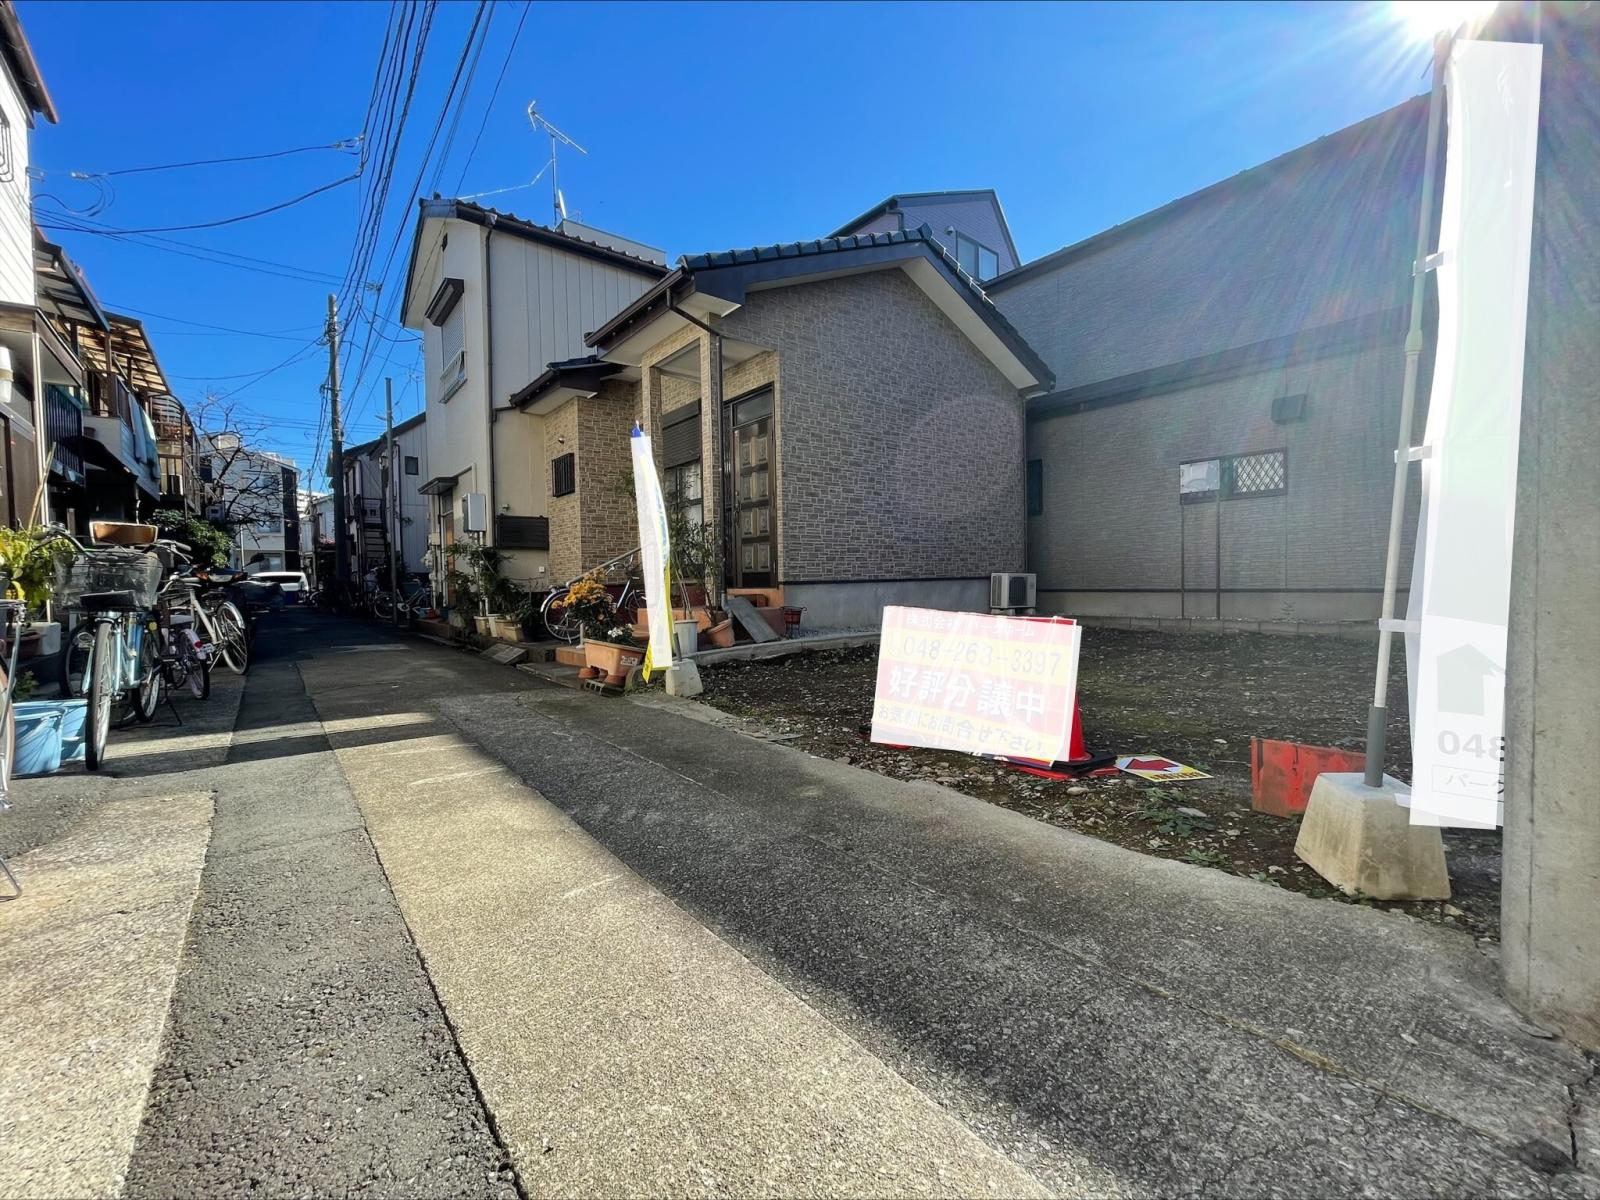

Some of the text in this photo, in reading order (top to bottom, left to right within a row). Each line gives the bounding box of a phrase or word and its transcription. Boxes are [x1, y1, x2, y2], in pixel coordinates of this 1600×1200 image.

[888, 665, 1045, 723] 好評分譲中
[1437, 729, 1505, 762] 048
